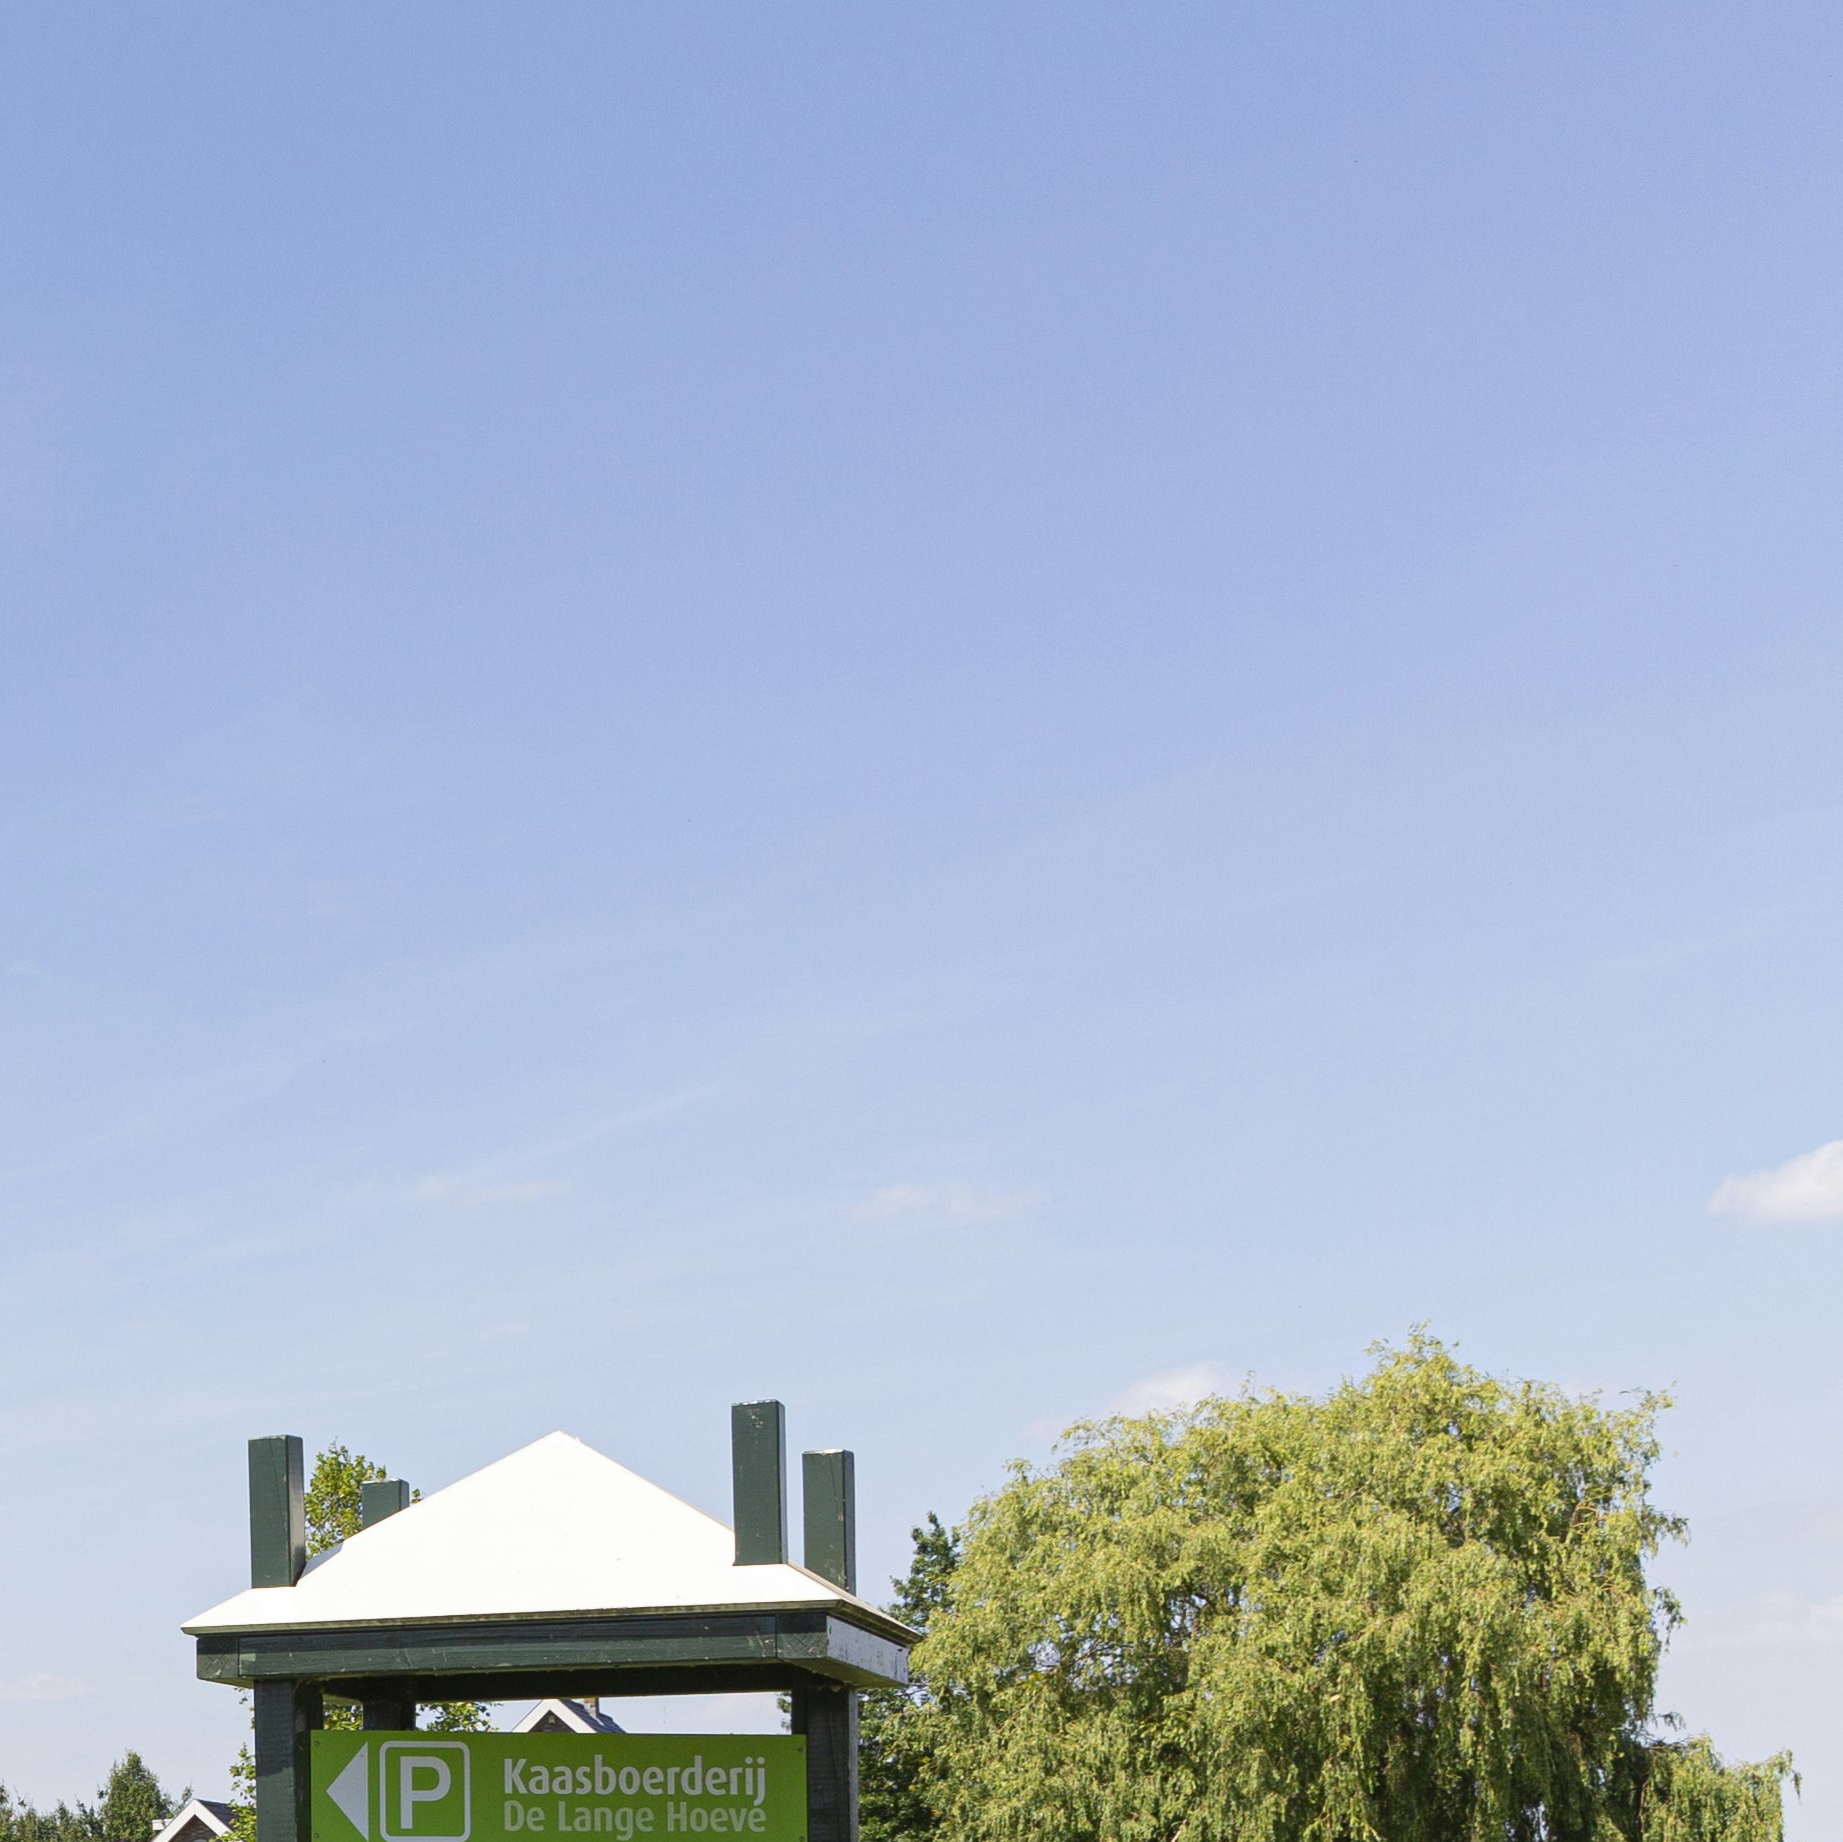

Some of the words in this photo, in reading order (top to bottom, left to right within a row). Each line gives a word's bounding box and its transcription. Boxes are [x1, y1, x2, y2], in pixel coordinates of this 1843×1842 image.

[400, 1757, 451, 1829] P
[504, 1755, 766, 1805] Kaasboerderij
[504, 1801, 545, 1833] De
[558, 1802, 654, 1840] Lange
[667, 1803, 765, 1833] Hoeve
